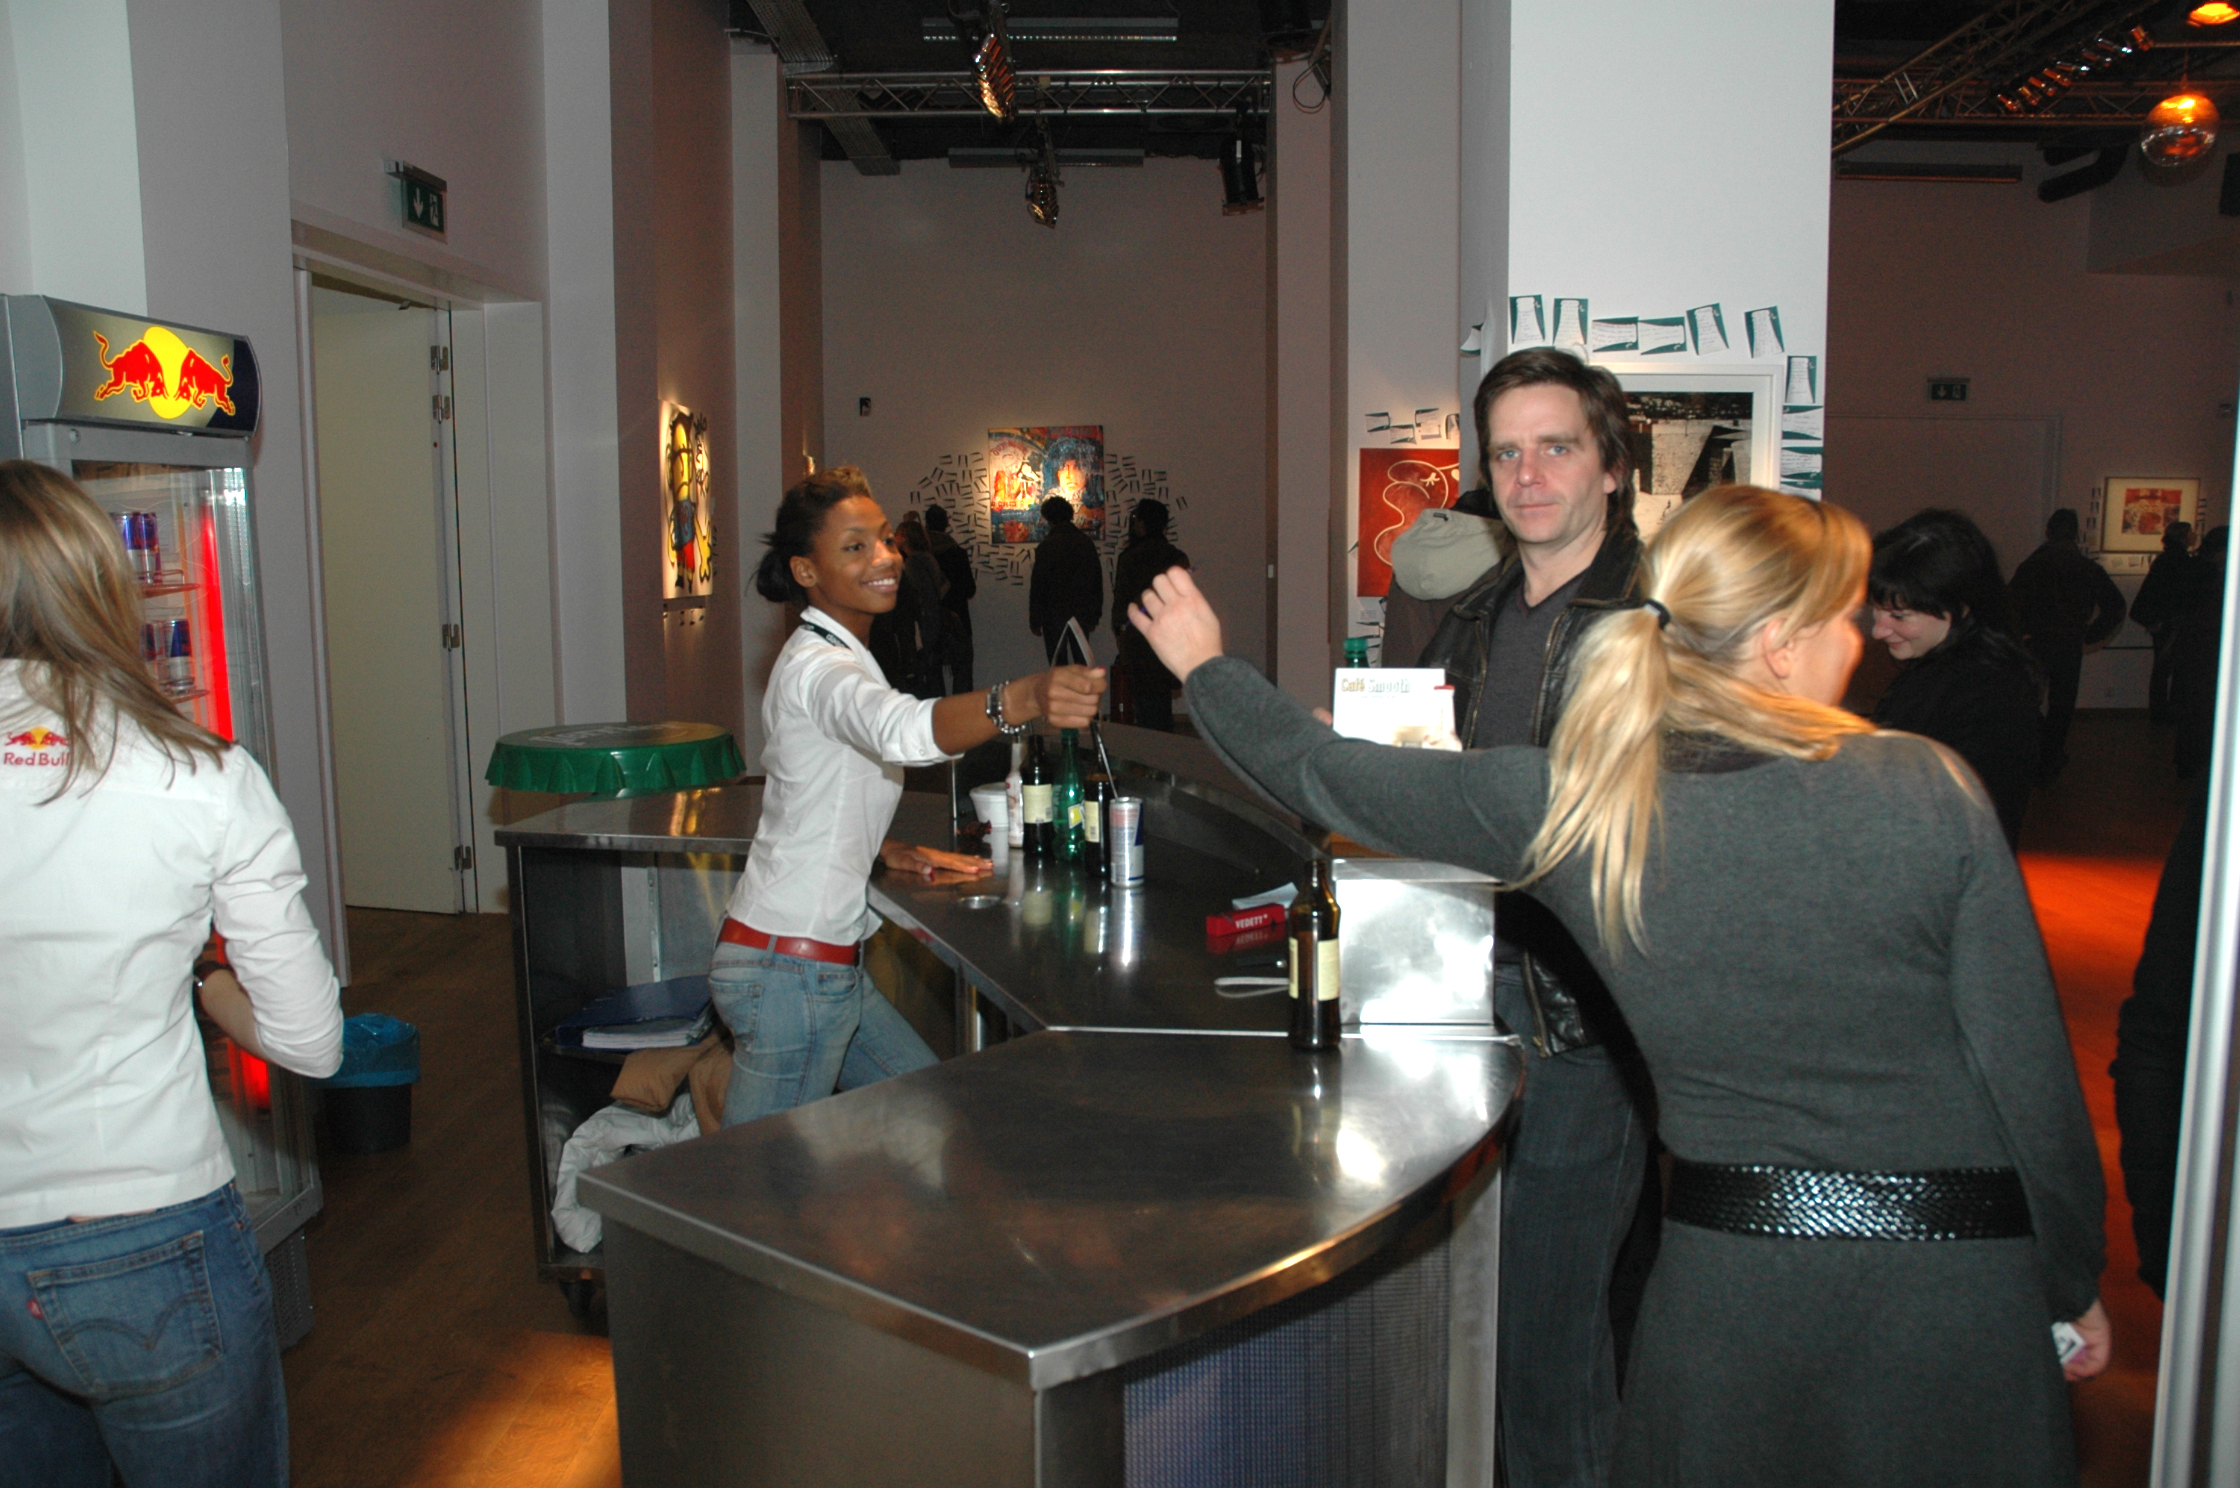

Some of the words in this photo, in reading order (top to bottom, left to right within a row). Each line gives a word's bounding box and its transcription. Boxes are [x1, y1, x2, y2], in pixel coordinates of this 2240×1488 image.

[1341, 677, 1365, 692] Café
[4, 751, 36, 766] Red
[38, 751, 70, 766] Bull
[1235, 915, 1263, 929] VEDETT
